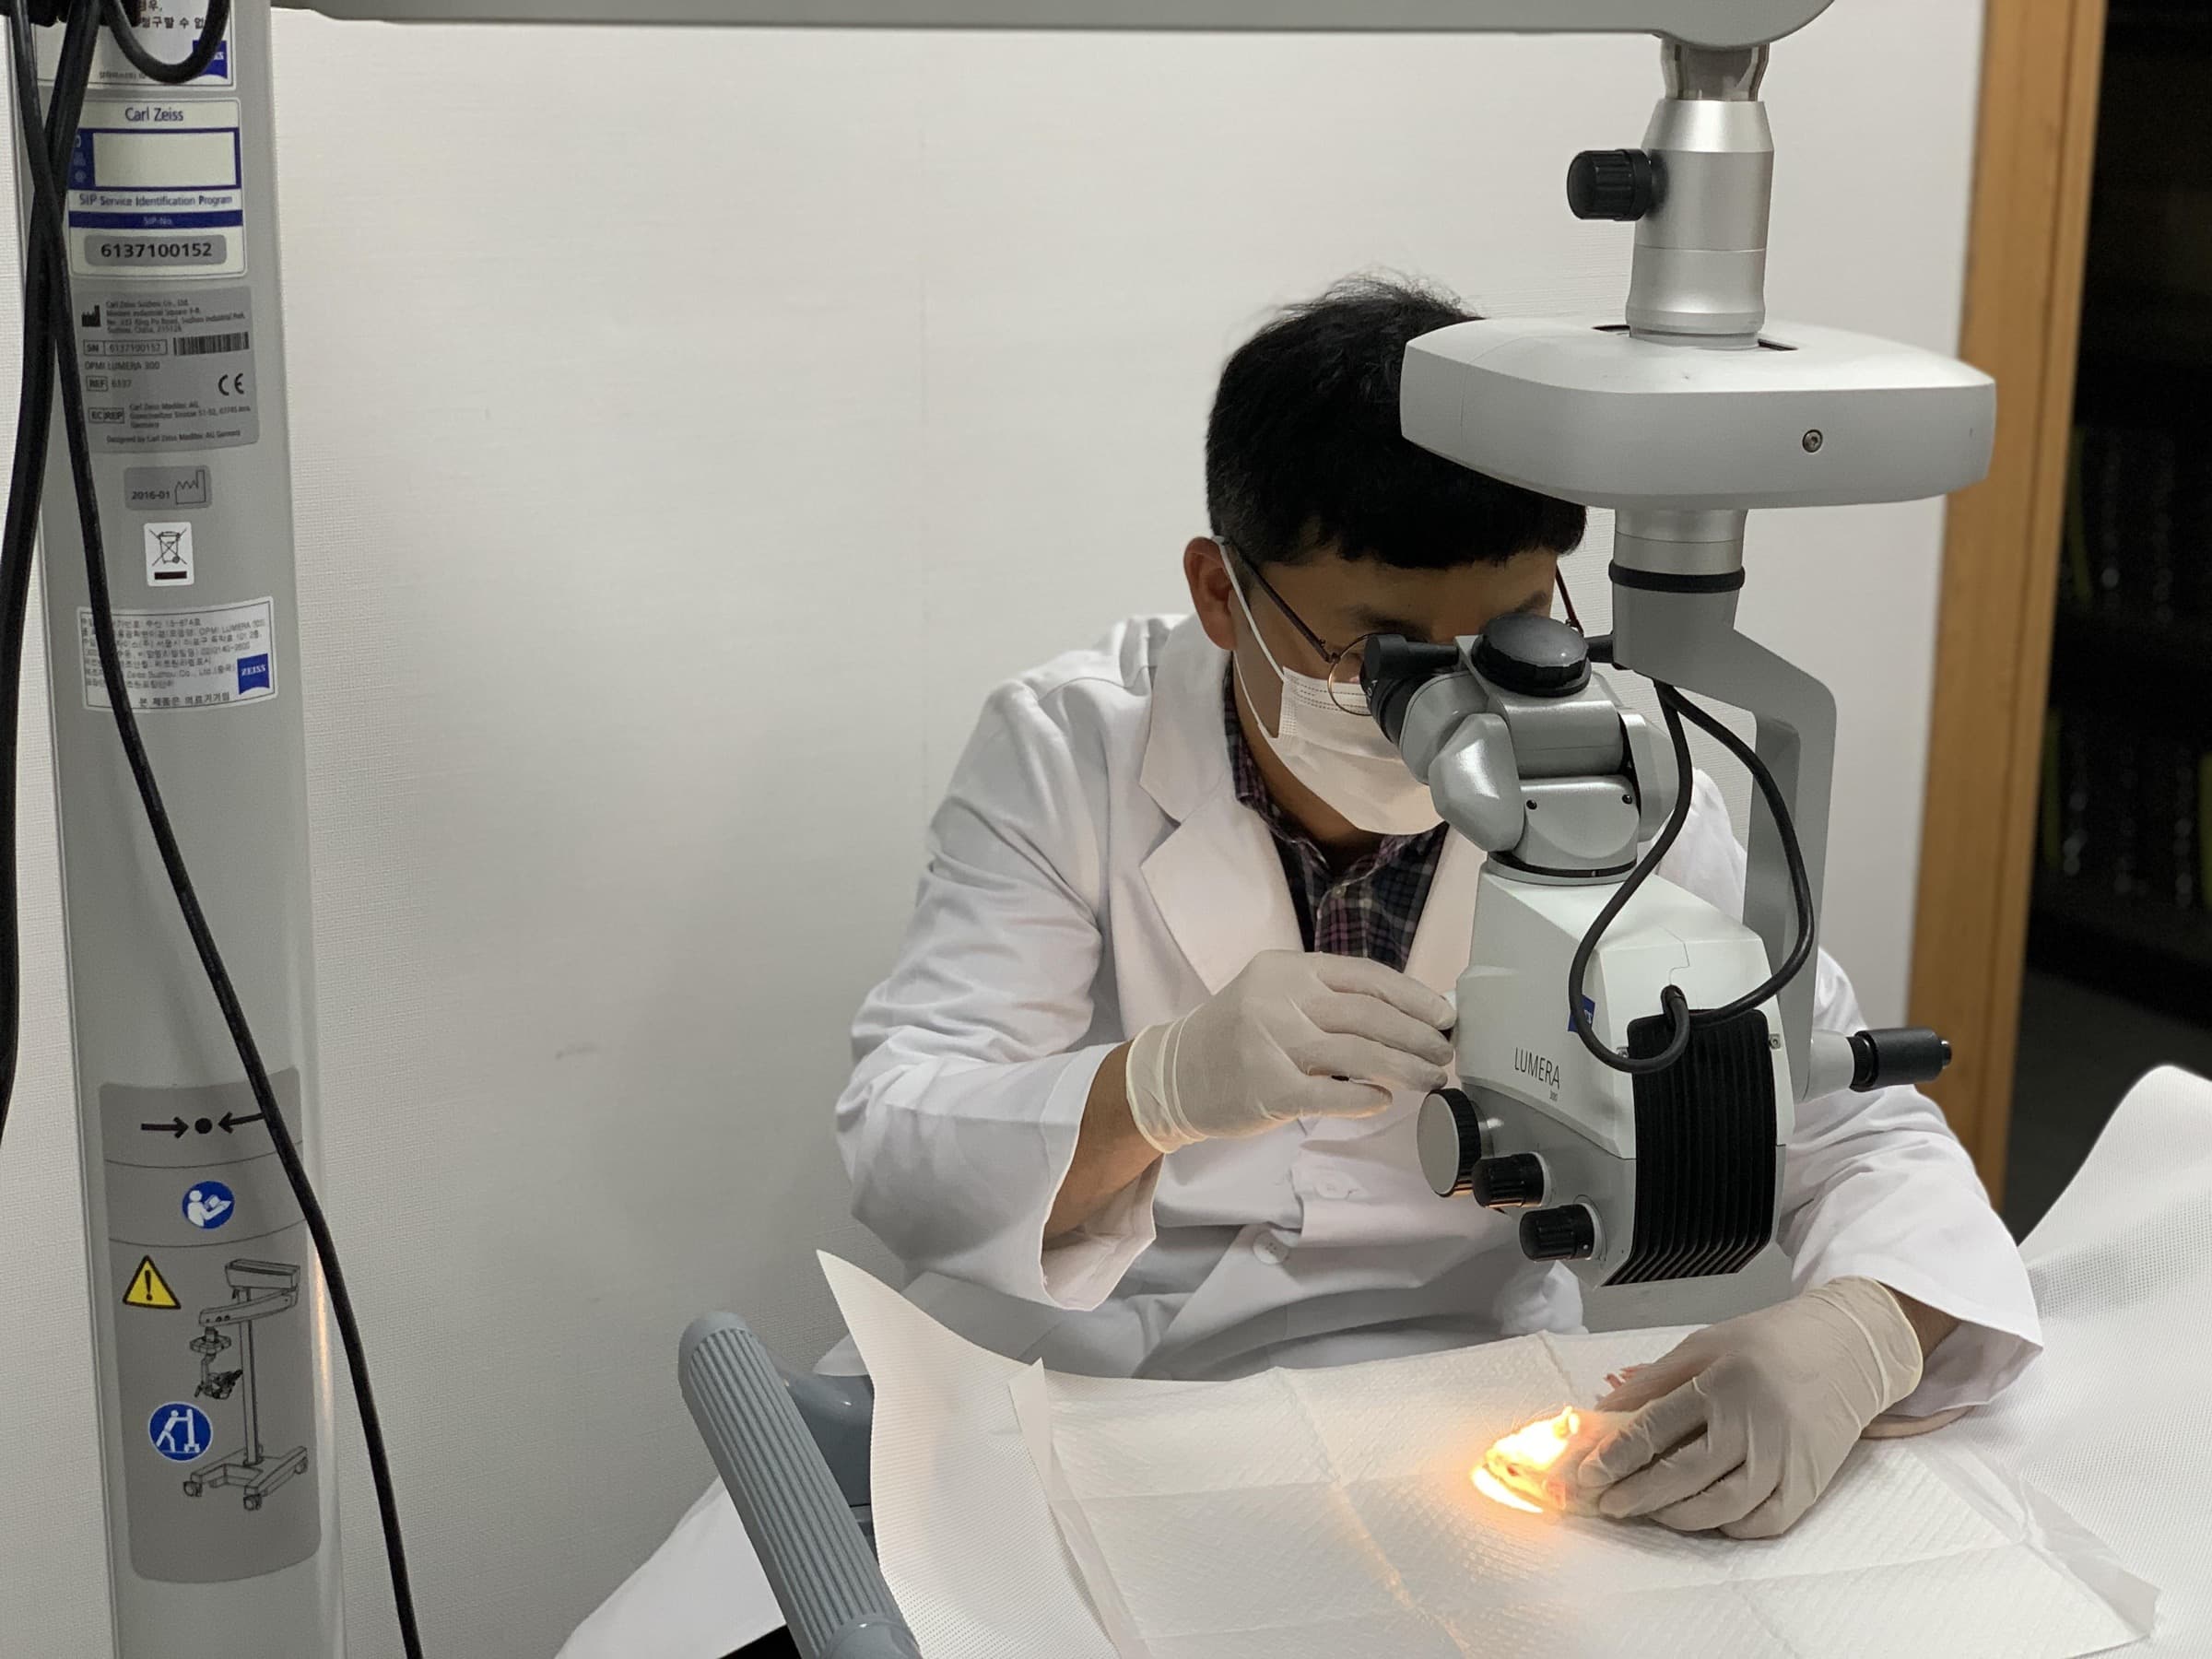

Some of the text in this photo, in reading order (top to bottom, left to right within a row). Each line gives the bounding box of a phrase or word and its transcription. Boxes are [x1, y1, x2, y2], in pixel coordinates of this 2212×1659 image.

[179, 17, 190, 29] 수
[124, 107, 183, 122] Carl Zeiss
[79, 193, 232, 207] SIP Service Identification Program
[100, 242, 212, 258] 6137100152
[85, 361, 160, 370] OPMI LUMERA 300
[132, 490, 171, 500] 2016-01
[241, 664, 266, 677] ZEISS
[1514, 1047, 1560, 1090] LUMERA
